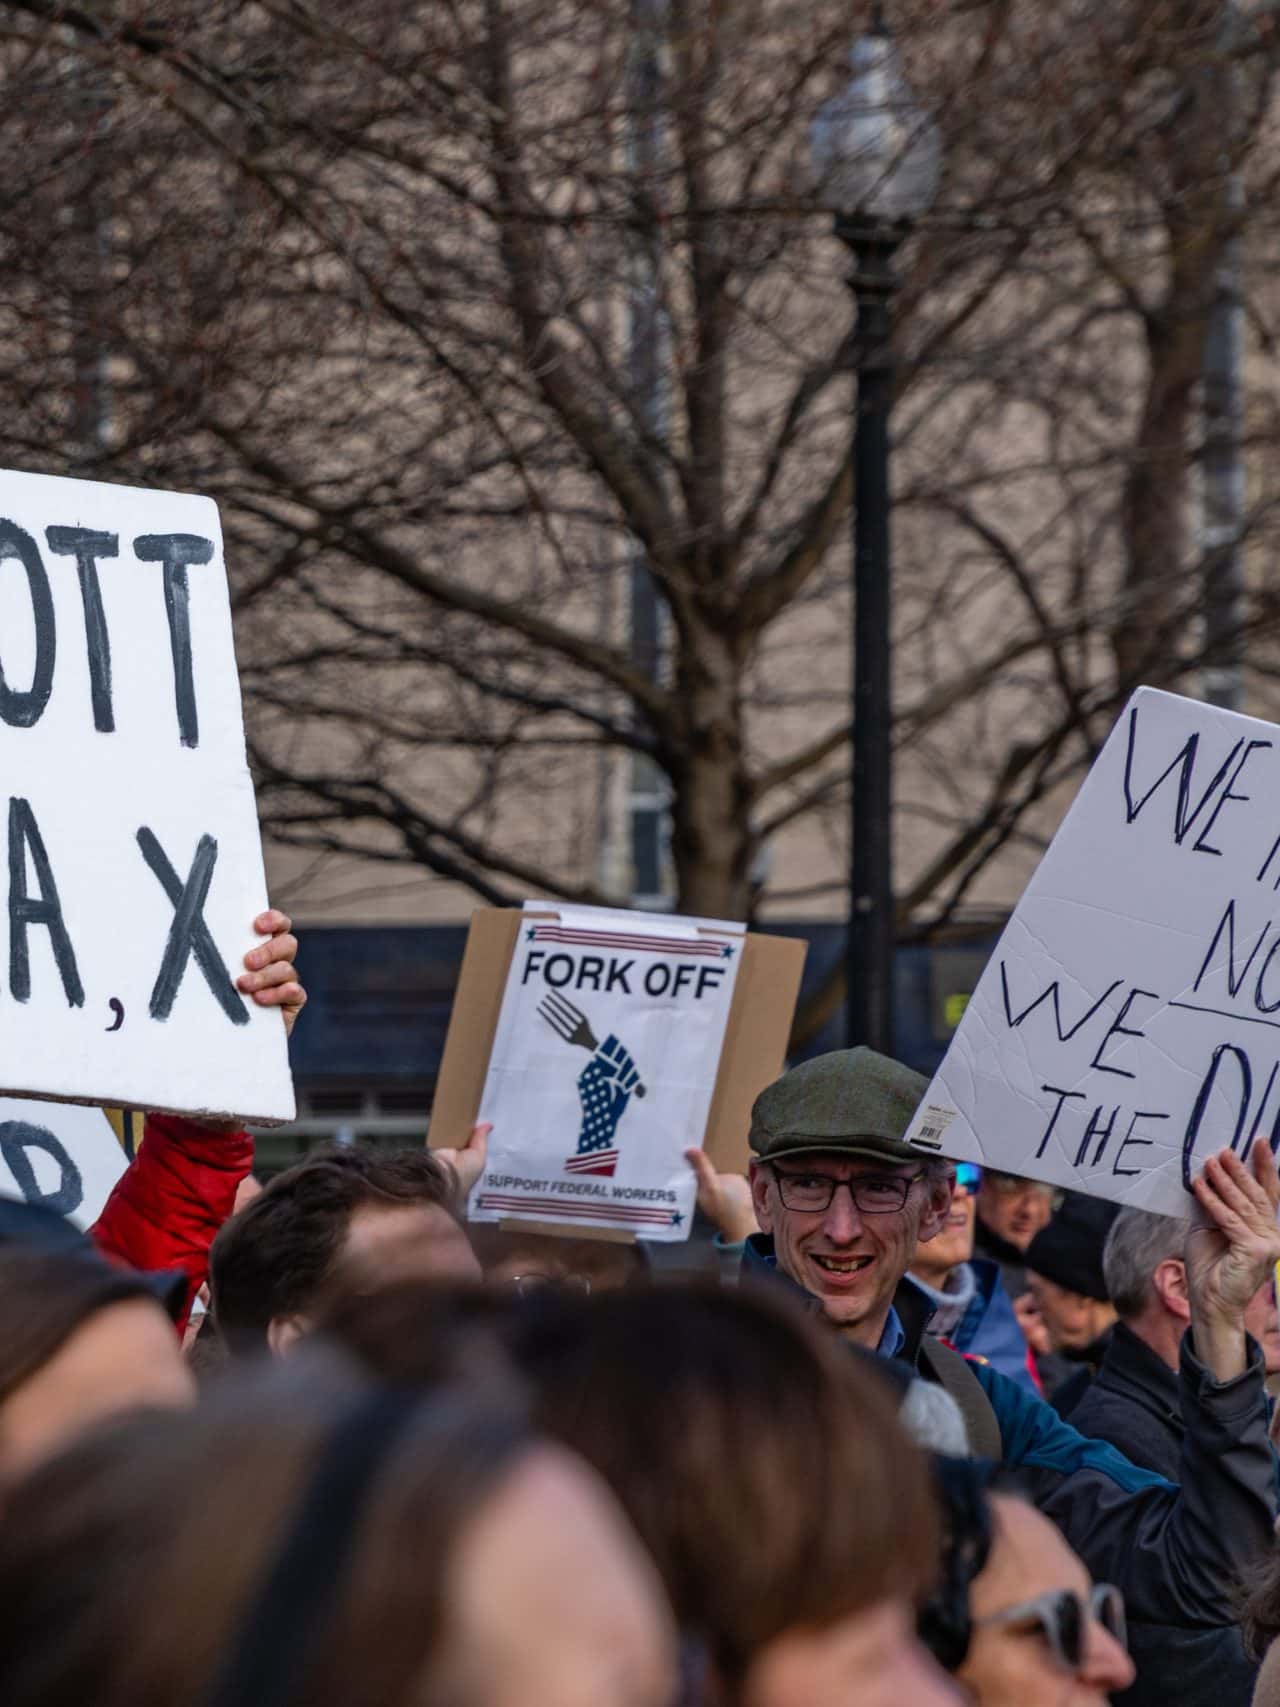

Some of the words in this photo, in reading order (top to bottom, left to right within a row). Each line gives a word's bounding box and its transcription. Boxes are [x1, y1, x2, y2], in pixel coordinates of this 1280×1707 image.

[1124, 707, 1273, 856] WE
[135, 826, 250, 1027] X
[521, 951, 636, 995] FORK
[644, 962, 726, 999] OFF
[1000, 960, 1160, 1078] WE
[1035, 1083, 1171, 1176] THE
[488, 1174, 549, 1192] SUPPORT
[550, 1181, 609, 1198] FEDERAL
[612, 1186, 678, 1203] WORKERS
